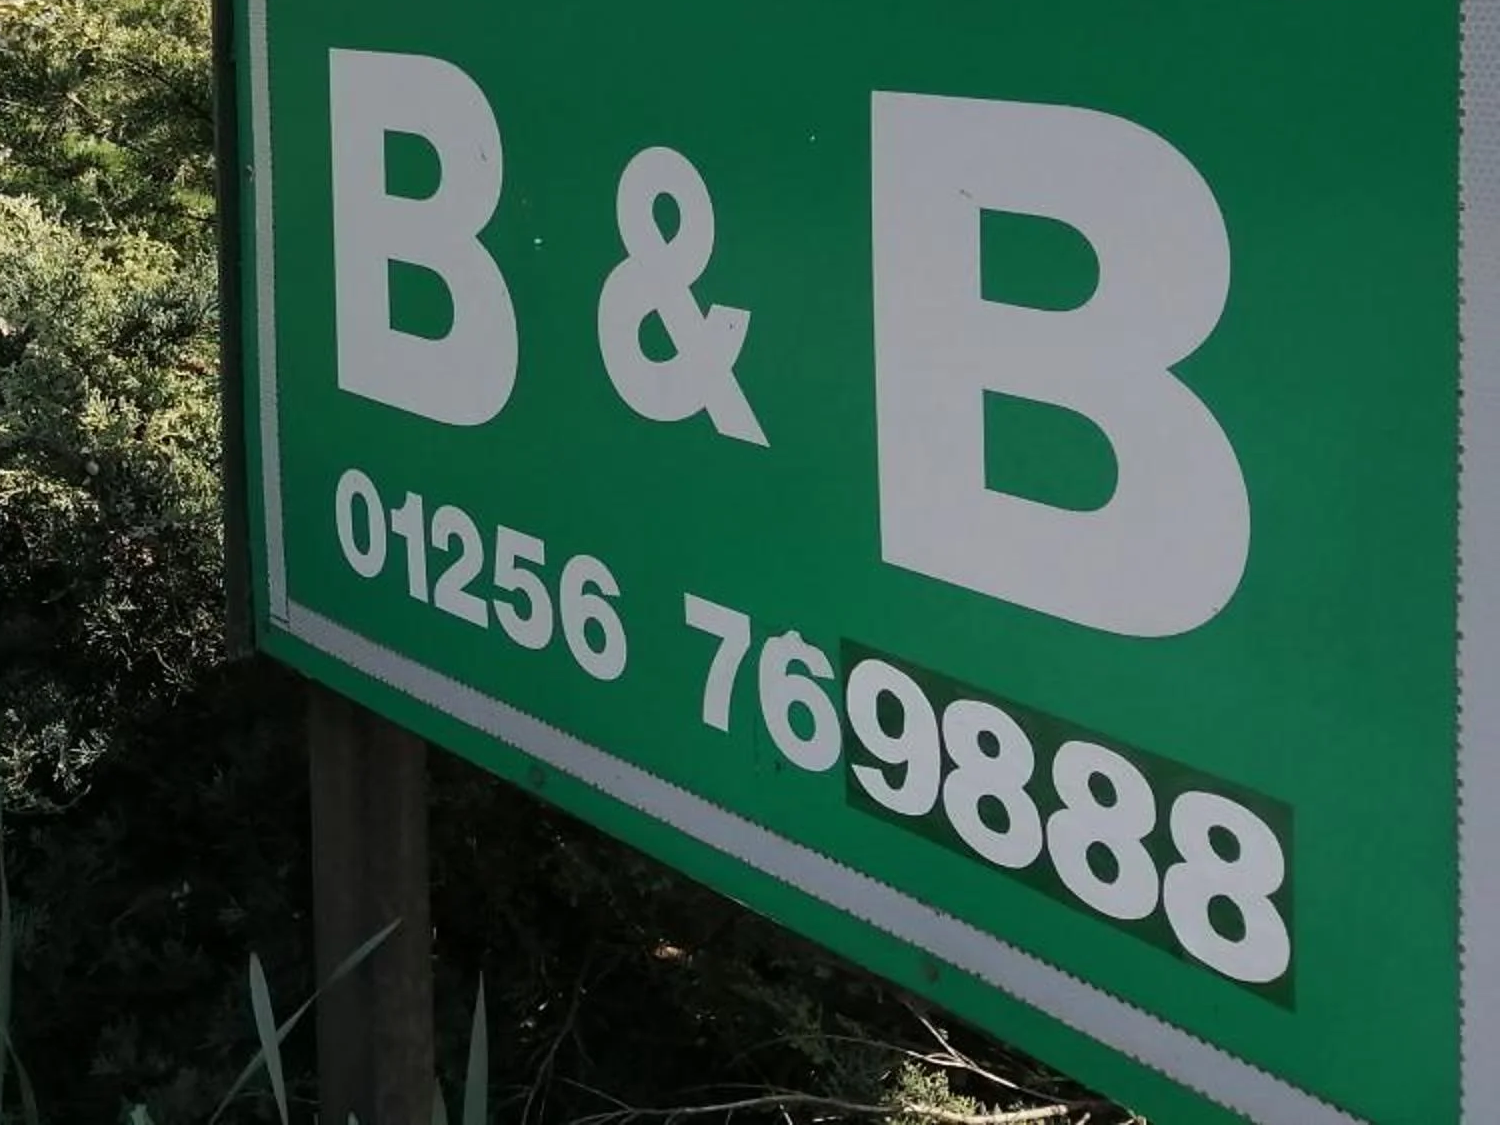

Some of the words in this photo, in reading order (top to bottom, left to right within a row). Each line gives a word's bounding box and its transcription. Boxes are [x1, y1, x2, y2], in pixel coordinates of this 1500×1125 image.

[330, 49, 518, 425] B
[598, 147, 768, 445] &
[872, 91, 1250, 637] B
[336, 470, 626, 679] 01256
[686, 596, 1290, 982] 769888
